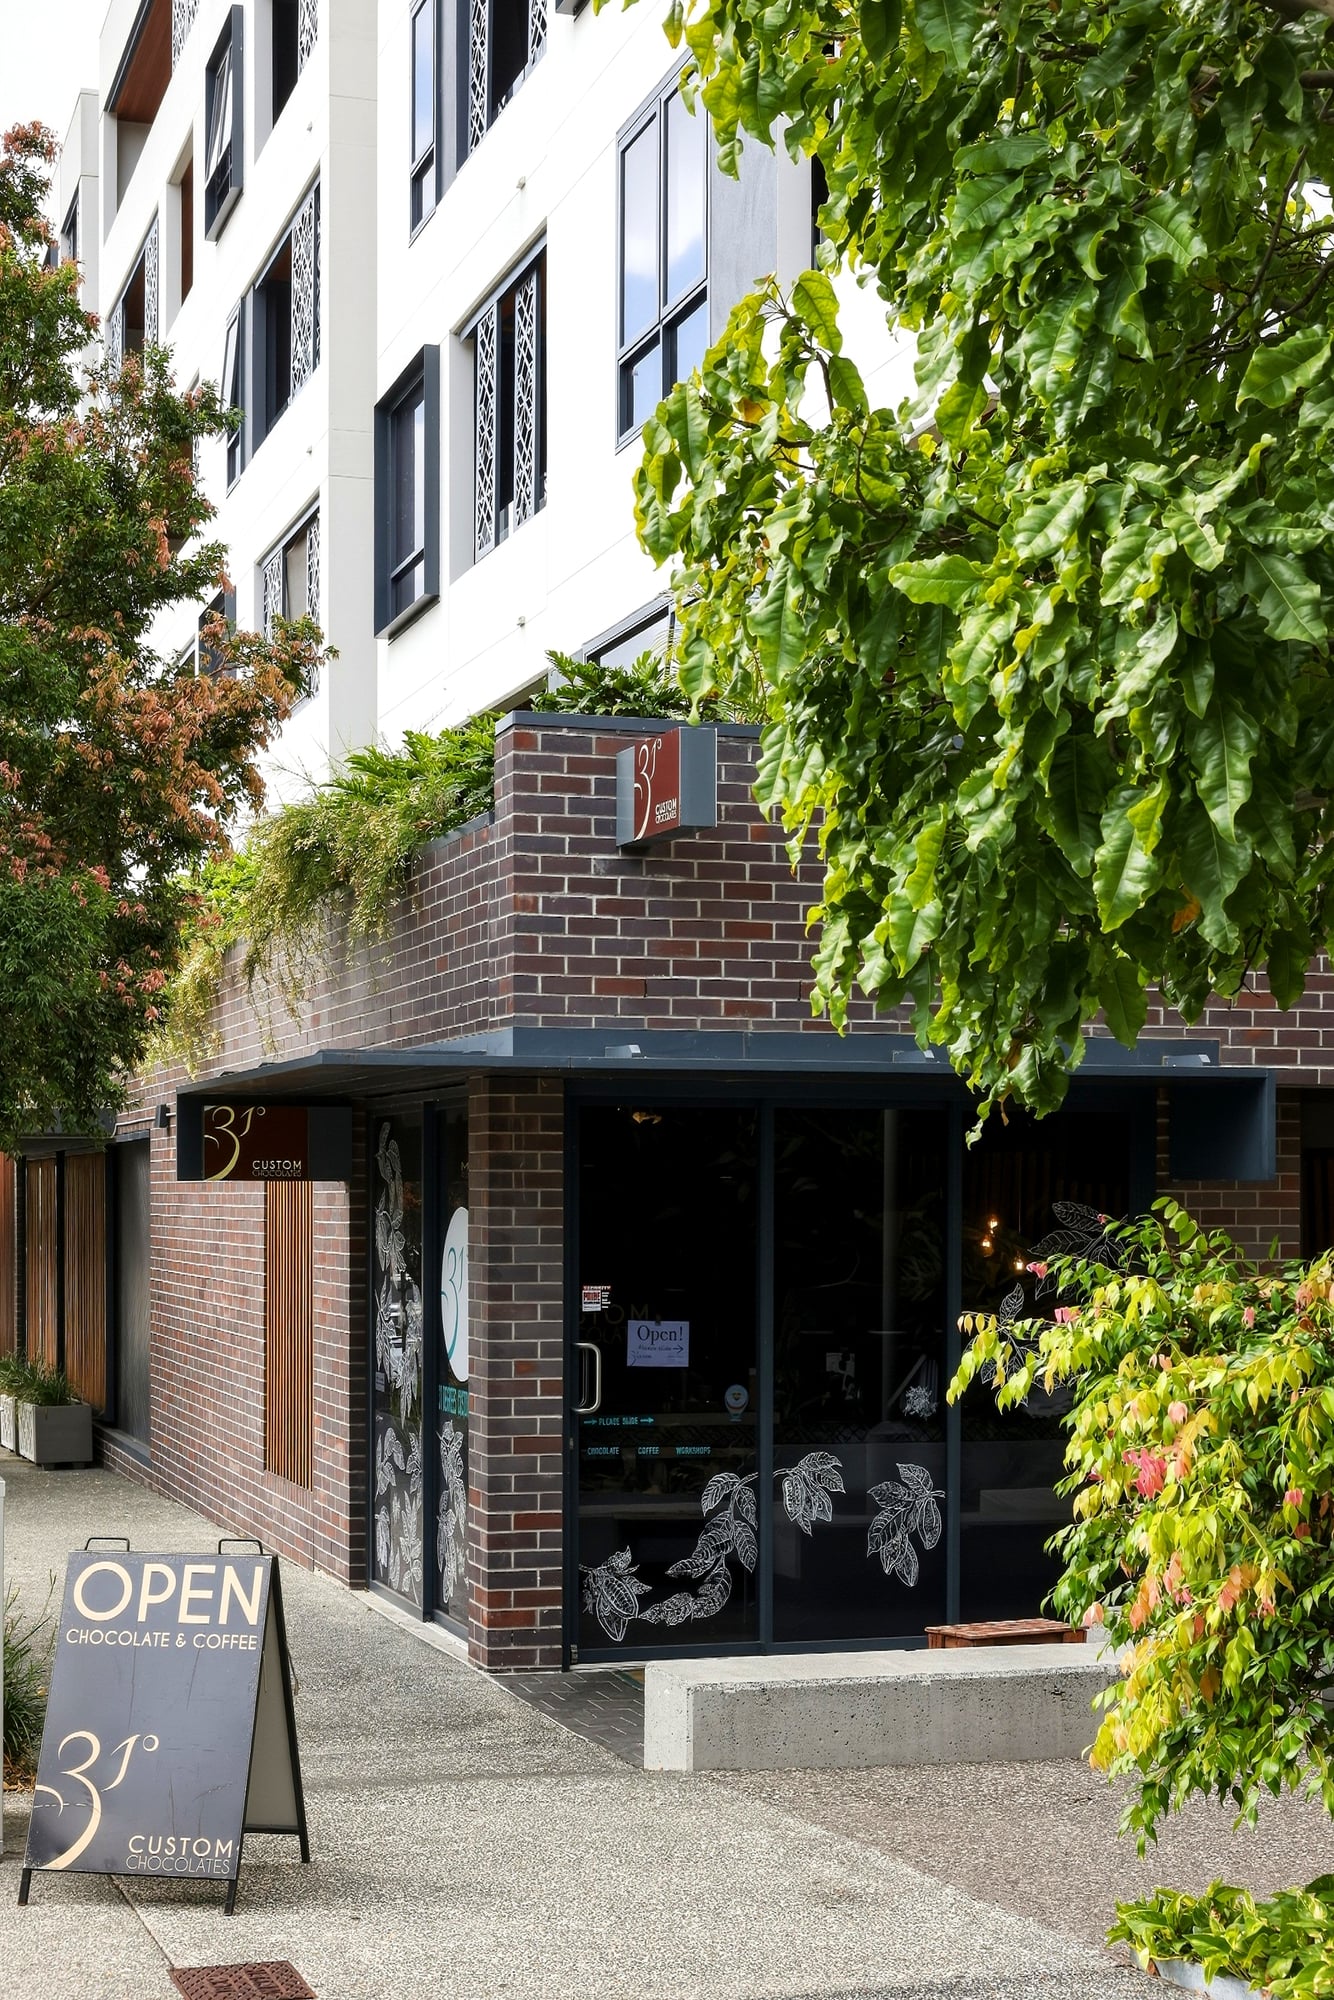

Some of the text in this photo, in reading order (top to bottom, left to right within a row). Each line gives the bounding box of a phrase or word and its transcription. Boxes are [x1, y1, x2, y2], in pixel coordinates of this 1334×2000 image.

[655, 798, 678, 816] CUSTOM
[252, 1160, 302, 1170] CUSTOM
[252, 1169, 302, 1177] CHOCOLATES
[637, 1325, 683, 1345] Open!
[598, 1416, 639, 1426] PLEASE SLIDE
[587, 1446, 712, 1456] CHOCOLATE COFFEE WORKSHOPS
[73, 1561, 264, 1626] OPEN
[66, 1629, 258, 1651] CHOCOLATE & COFFEE
[128, 1834, 234, 1859] CUSTOM
[125, 1854, 231, 1875] CHOCOLATES
